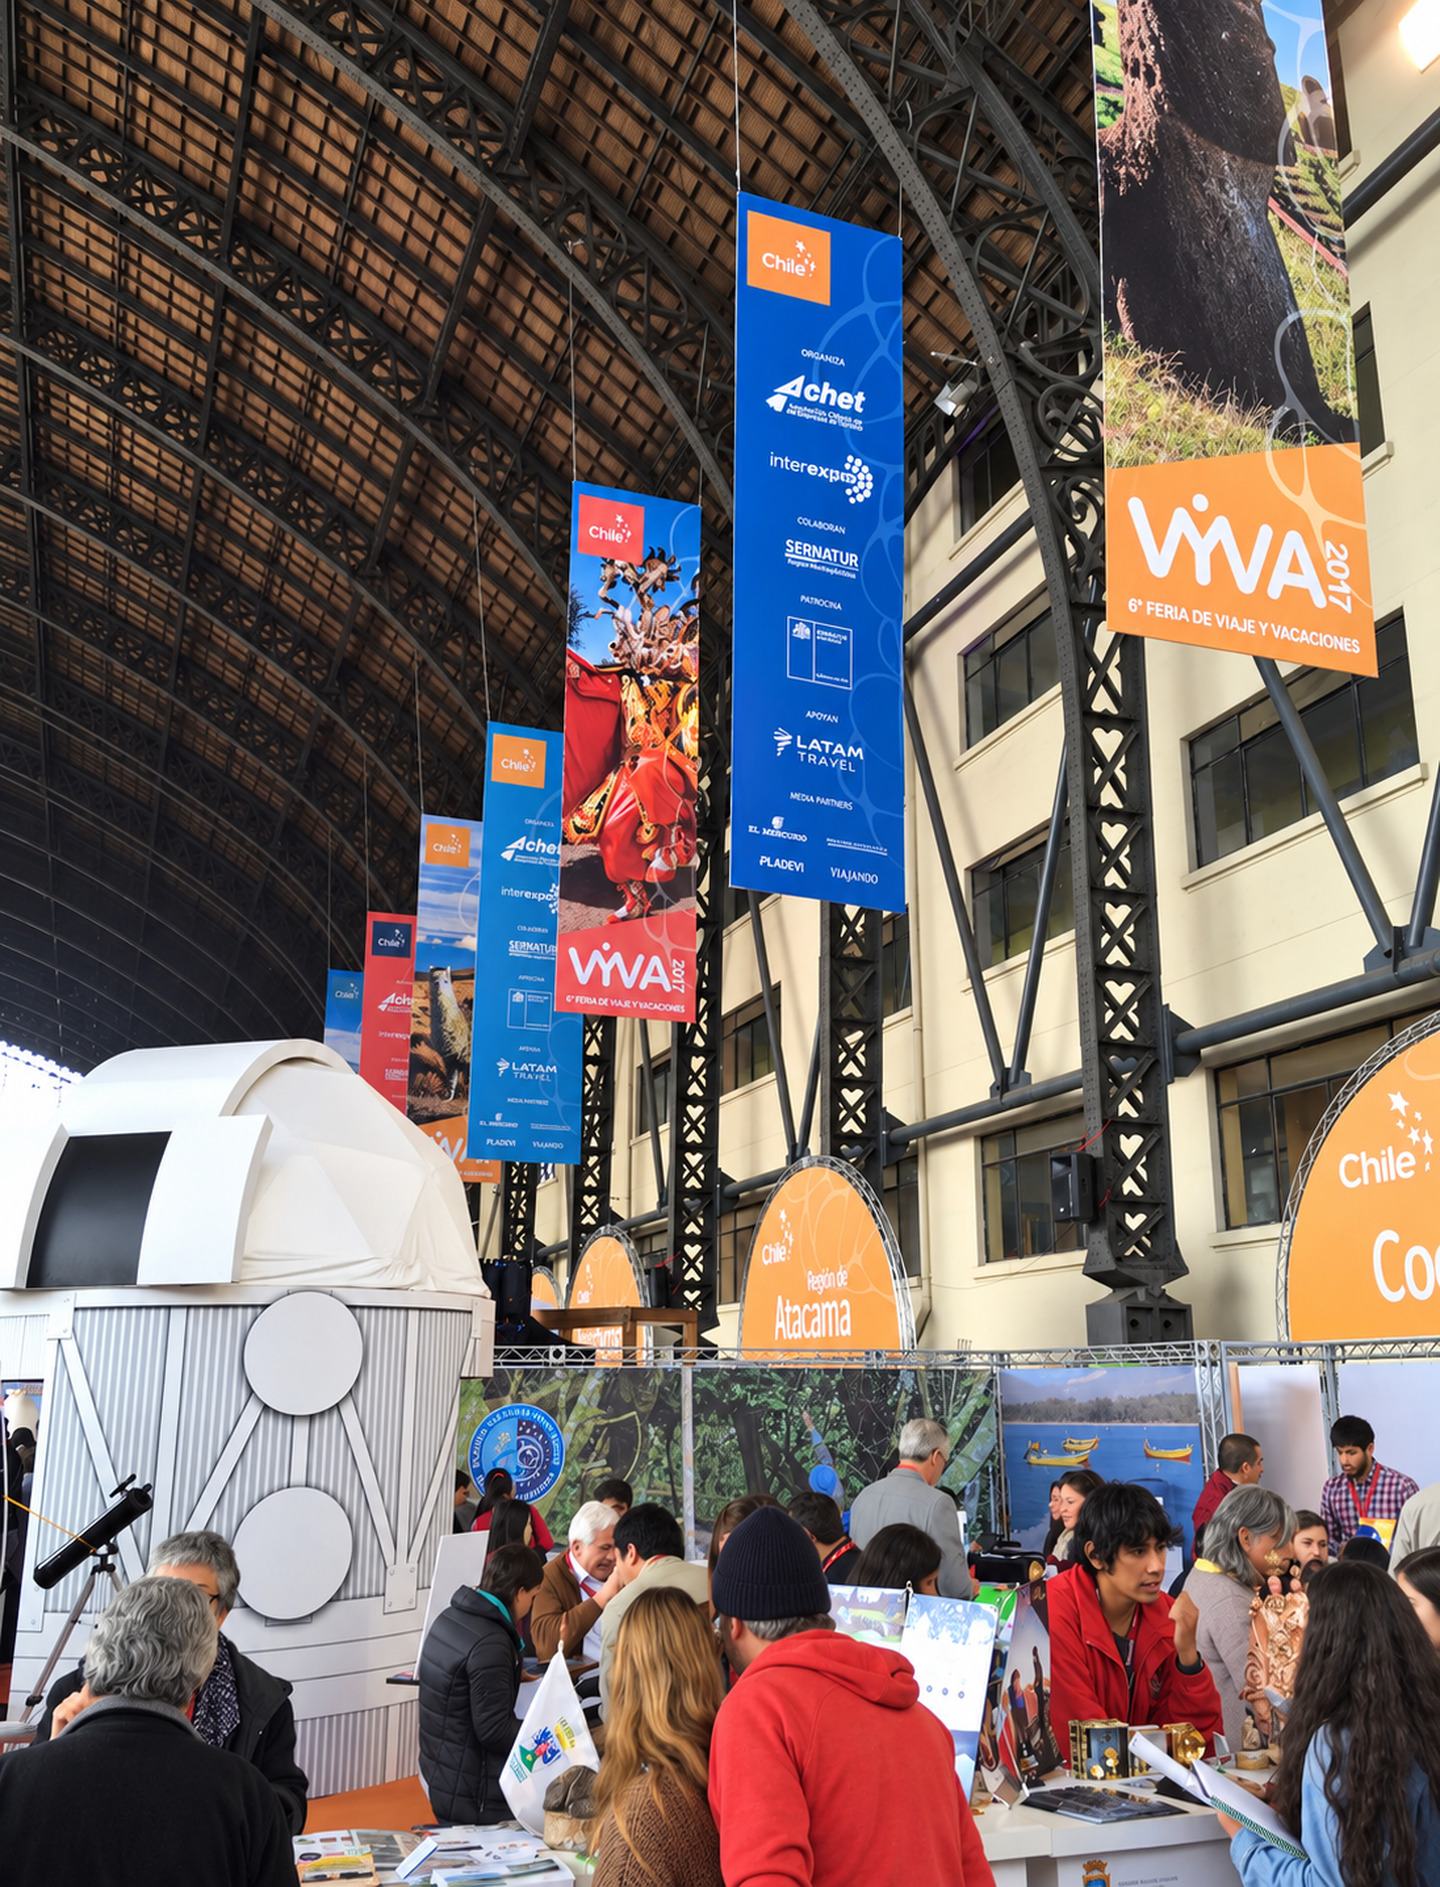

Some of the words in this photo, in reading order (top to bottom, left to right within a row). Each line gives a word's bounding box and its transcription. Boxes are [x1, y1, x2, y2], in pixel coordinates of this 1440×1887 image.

[762, 252, 805, 276] Chile
[801, 349, 845, 367] ORGANIZA
[766, 375, 866, 413] Achet
[589, 525, 624, 543] Chile
[796, 516, 846, 534] COLABORAN
[785, 538, 859, 567] SERNATUR
[1325, 540, 1352, 614] 2017
[800, 594, 842, 610] PATROCINA
[1146, 601, 1189, 622] FERIA
[1193, 609, 1212, 627] DE
[1215, 613, 1255, 634] VIAJE
[1259, 622, 1269, 637] Y
[1271, 624, 1360, 654] VACACIONES
[805, 710, 839, 723] APOYAN
[796, 735, 864, 760] LATAM
[797, 751, 856, 772] TRAVEL
[789, 791, 814, 803] MEDIA
[748, 825, 760, 835] EL
[759, 855, 804, 873] PLADEVI
[830, 867, 878, 885] VIAJANDO
[672, 959, 685, 993] 2017
[598, 997, 609, 1006] DE
[512, 1062, 557, 1073] LATAM
[1339, 1146, 1416, 1188] Chile
[762, 1243, 786, 1265] Chile
[836, 1265, 848, 1288] de
[1372, 1229, 1440, 1303] Co
[775, 1295, 851, 1341] Atacama
